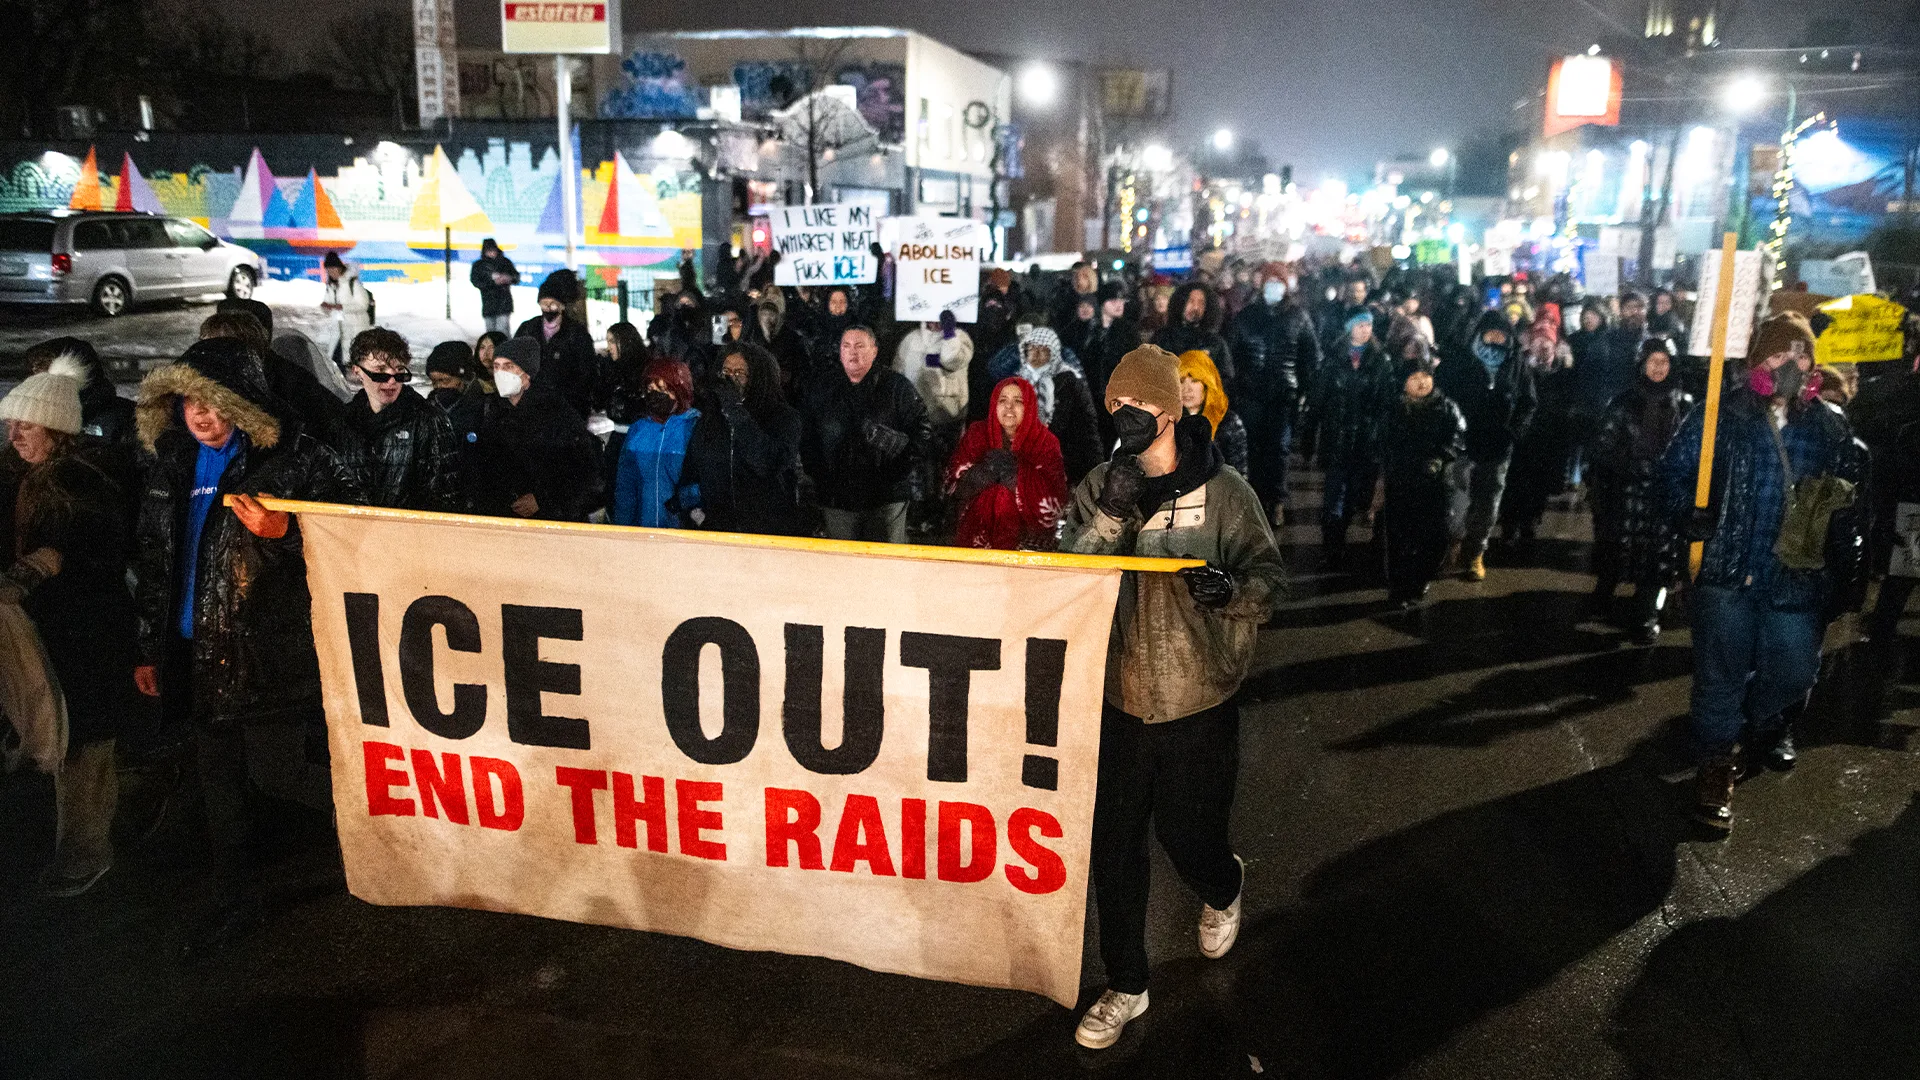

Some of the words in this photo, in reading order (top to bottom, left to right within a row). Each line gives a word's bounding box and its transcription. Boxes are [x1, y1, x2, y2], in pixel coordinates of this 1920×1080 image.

[784, 210, 791, 228] I
[803, 207, 838, 227] LIKE
[848, 206, 871, 227] MY
[842, 230, 875, 252] NEAT
[898, 243, 974, 261] ABOLISH
[923, 268, 953, 284] ICE
[344, 592, 590, 750] ICE
[662, 617, 1067, 791] OUT!
[363, 741, 525, 831] END
[556, 766, 727, 861] THE
[765, 787, 1067, 895] RAIDS
